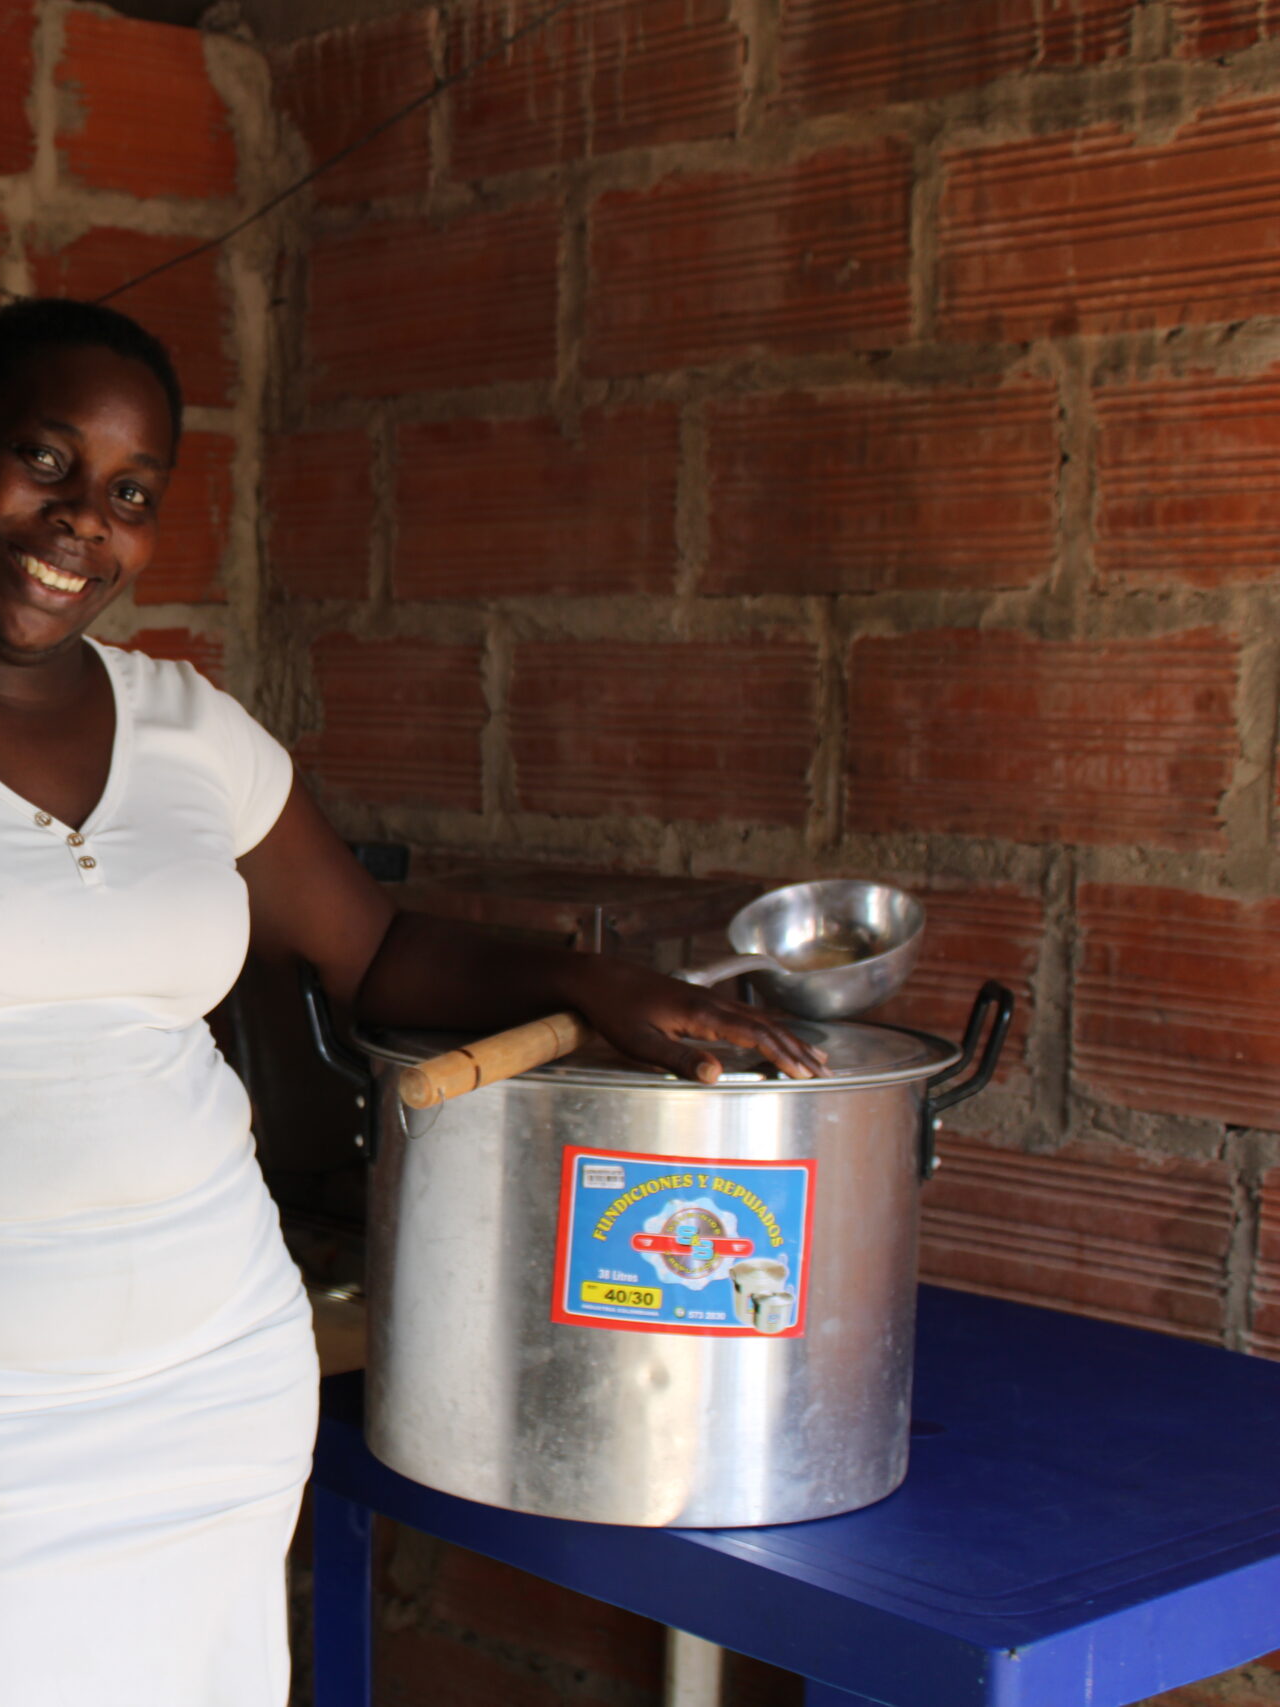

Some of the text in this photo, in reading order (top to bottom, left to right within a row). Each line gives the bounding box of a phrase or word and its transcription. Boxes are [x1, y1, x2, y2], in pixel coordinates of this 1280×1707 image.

[592, 1174, 784, 1247] FUNDICIONES Y REPUJADOS
[612, 1270, 639, 1282] Litros
[604, 1289, 654, 1306] 40/30
